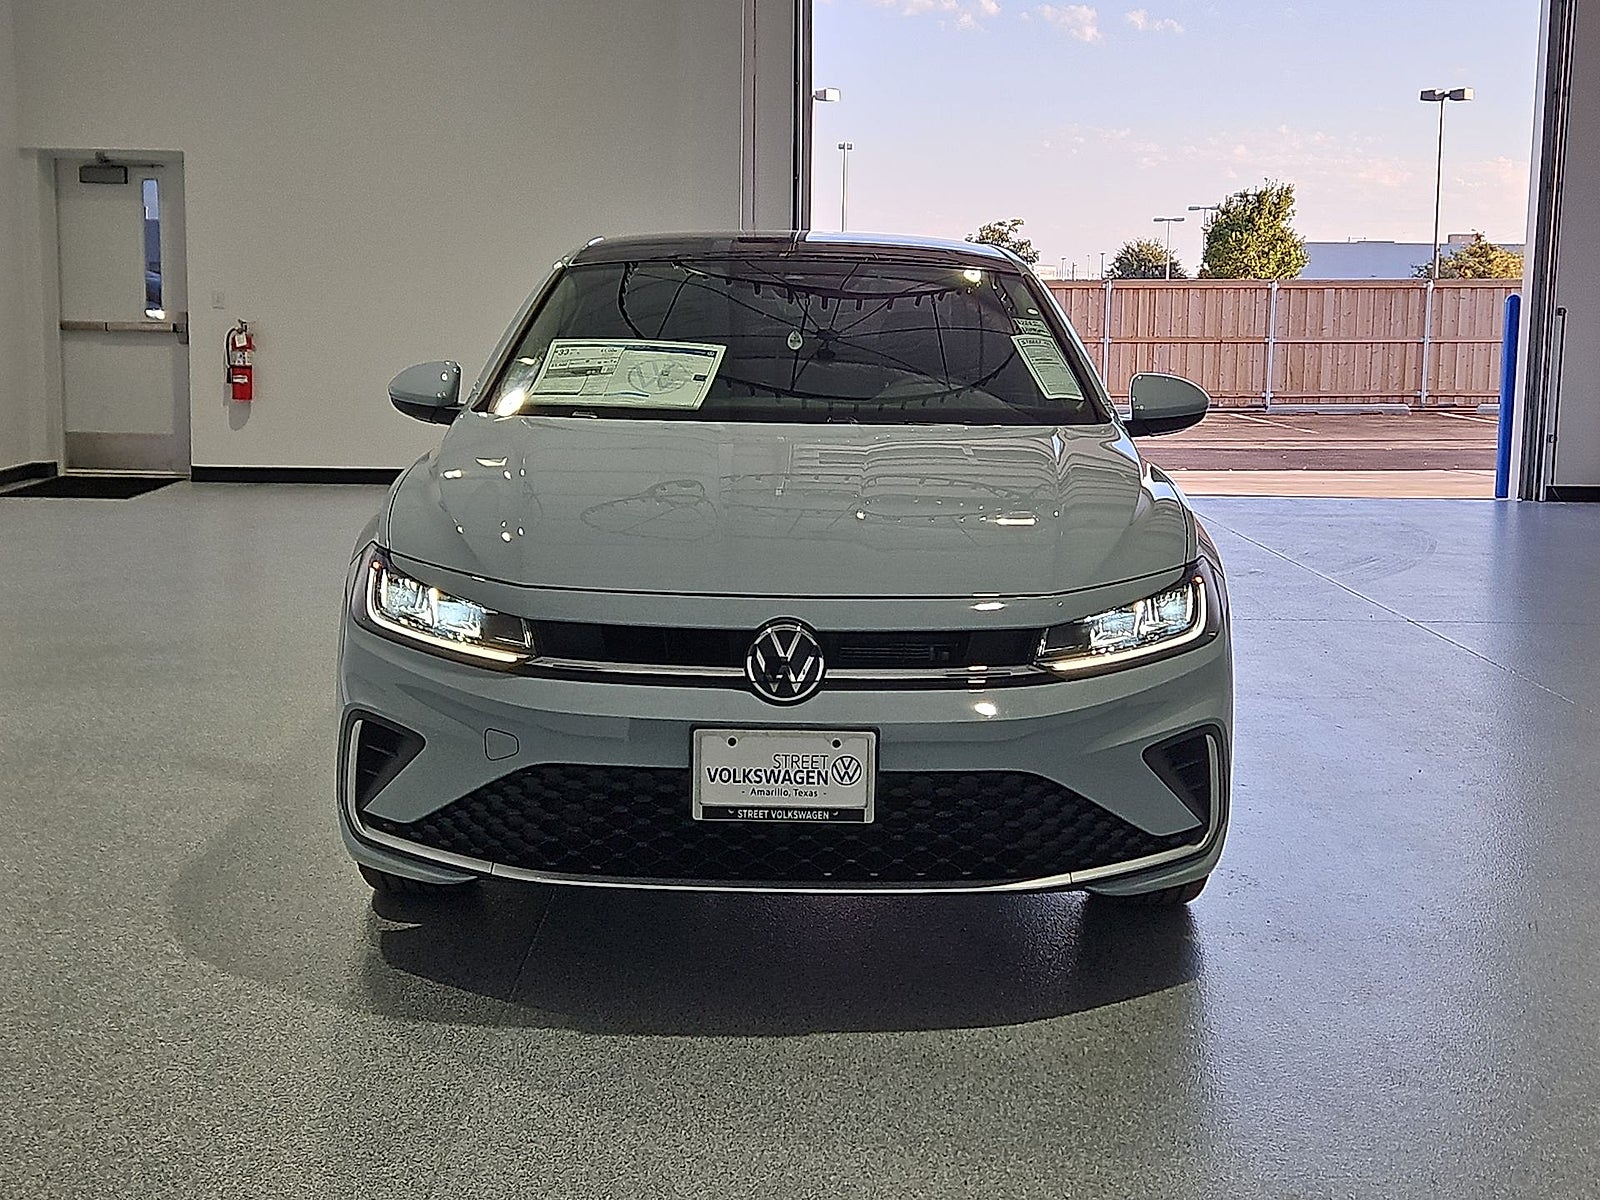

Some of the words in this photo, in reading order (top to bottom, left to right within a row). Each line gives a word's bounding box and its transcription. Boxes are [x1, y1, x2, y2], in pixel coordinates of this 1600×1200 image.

[772, 754, 829, 770] STREET
[706, 767, 829, 786] VOLKSWAGEN
[750, 787, 791, 798] Amarillo,
[793, 788, 818, 798] Texas
[737, 809, 768, 819] STREET
[771, 809, 829, 820] VOLKSWAGEN
